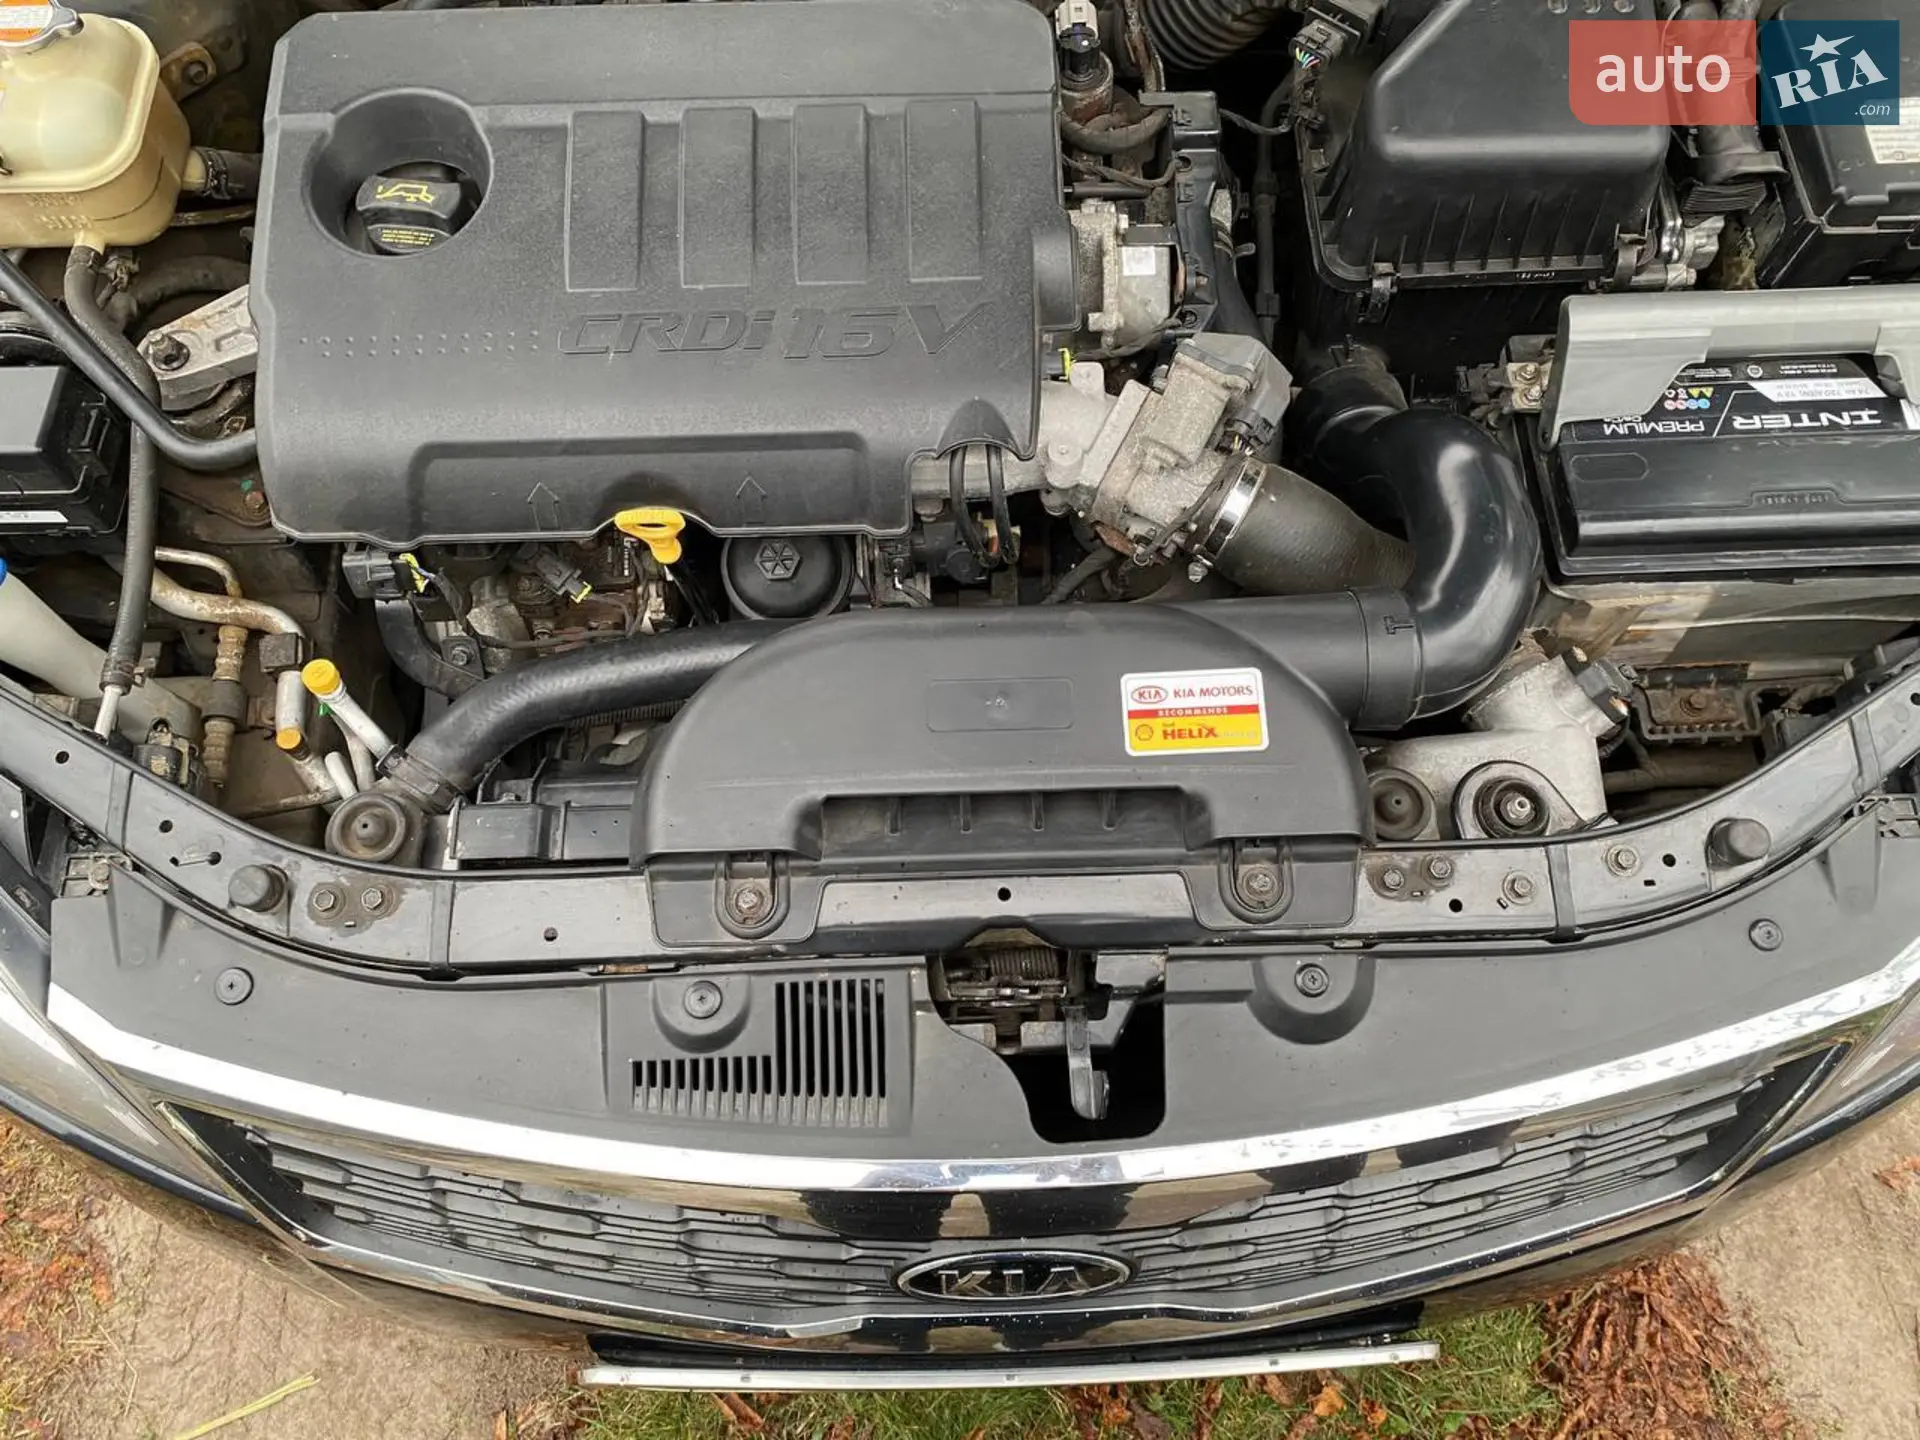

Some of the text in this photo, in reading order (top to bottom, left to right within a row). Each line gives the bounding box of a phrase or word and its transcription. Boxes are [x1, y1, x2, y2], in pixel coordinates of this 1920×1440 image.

[1603, 416, 1705, 436] PREMIUM
[1731, 410, 1882, 429] INTER
[1137, 685, 1254, 700] KIA KIA MOTORS
[1157, 706, 1229, 718] RECOMMENDS
[1162, 726, 1219, 741] HELIX
[937, 1266, 1093, 1297] KIA
